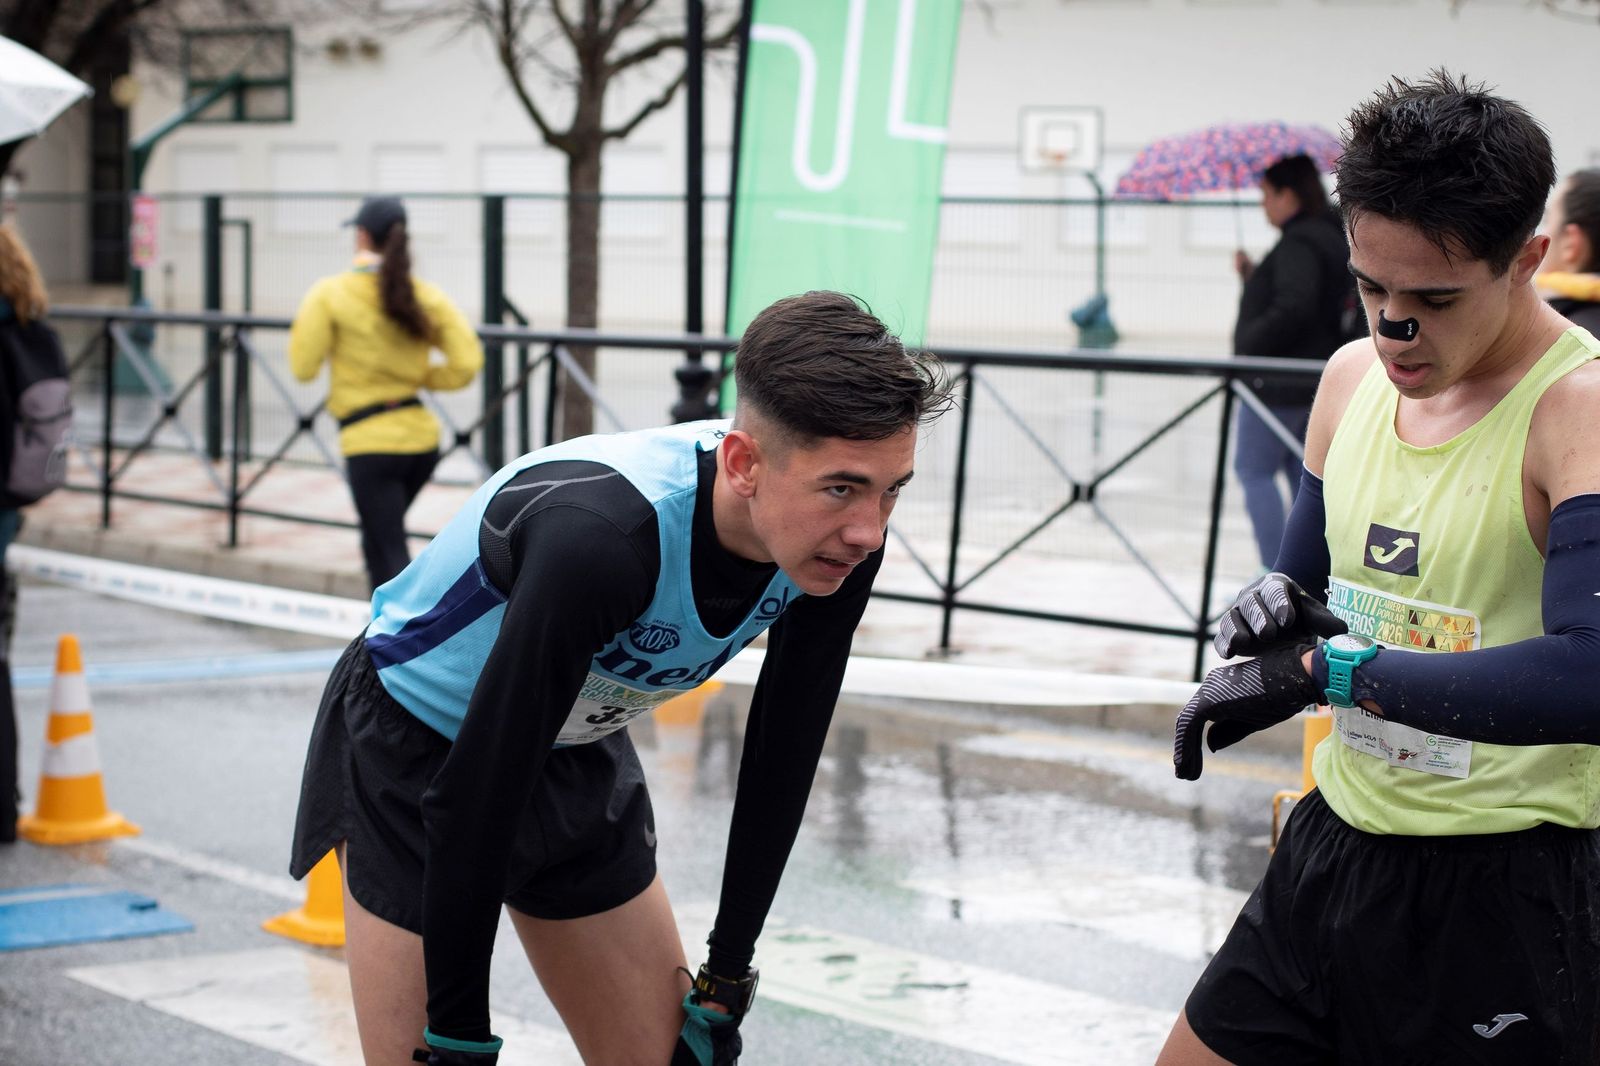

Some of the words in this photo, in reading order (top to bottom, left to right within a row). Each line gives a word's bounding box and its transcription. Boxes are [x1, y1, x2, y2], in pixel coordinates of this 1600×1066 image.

[1348, 590, 1380, 616] XIII
[1379, 599, 1406, 613] CARRERA
[1376, 610, 1405, 624] POPULAR
[1376, 621, 1403, 645] 2026
